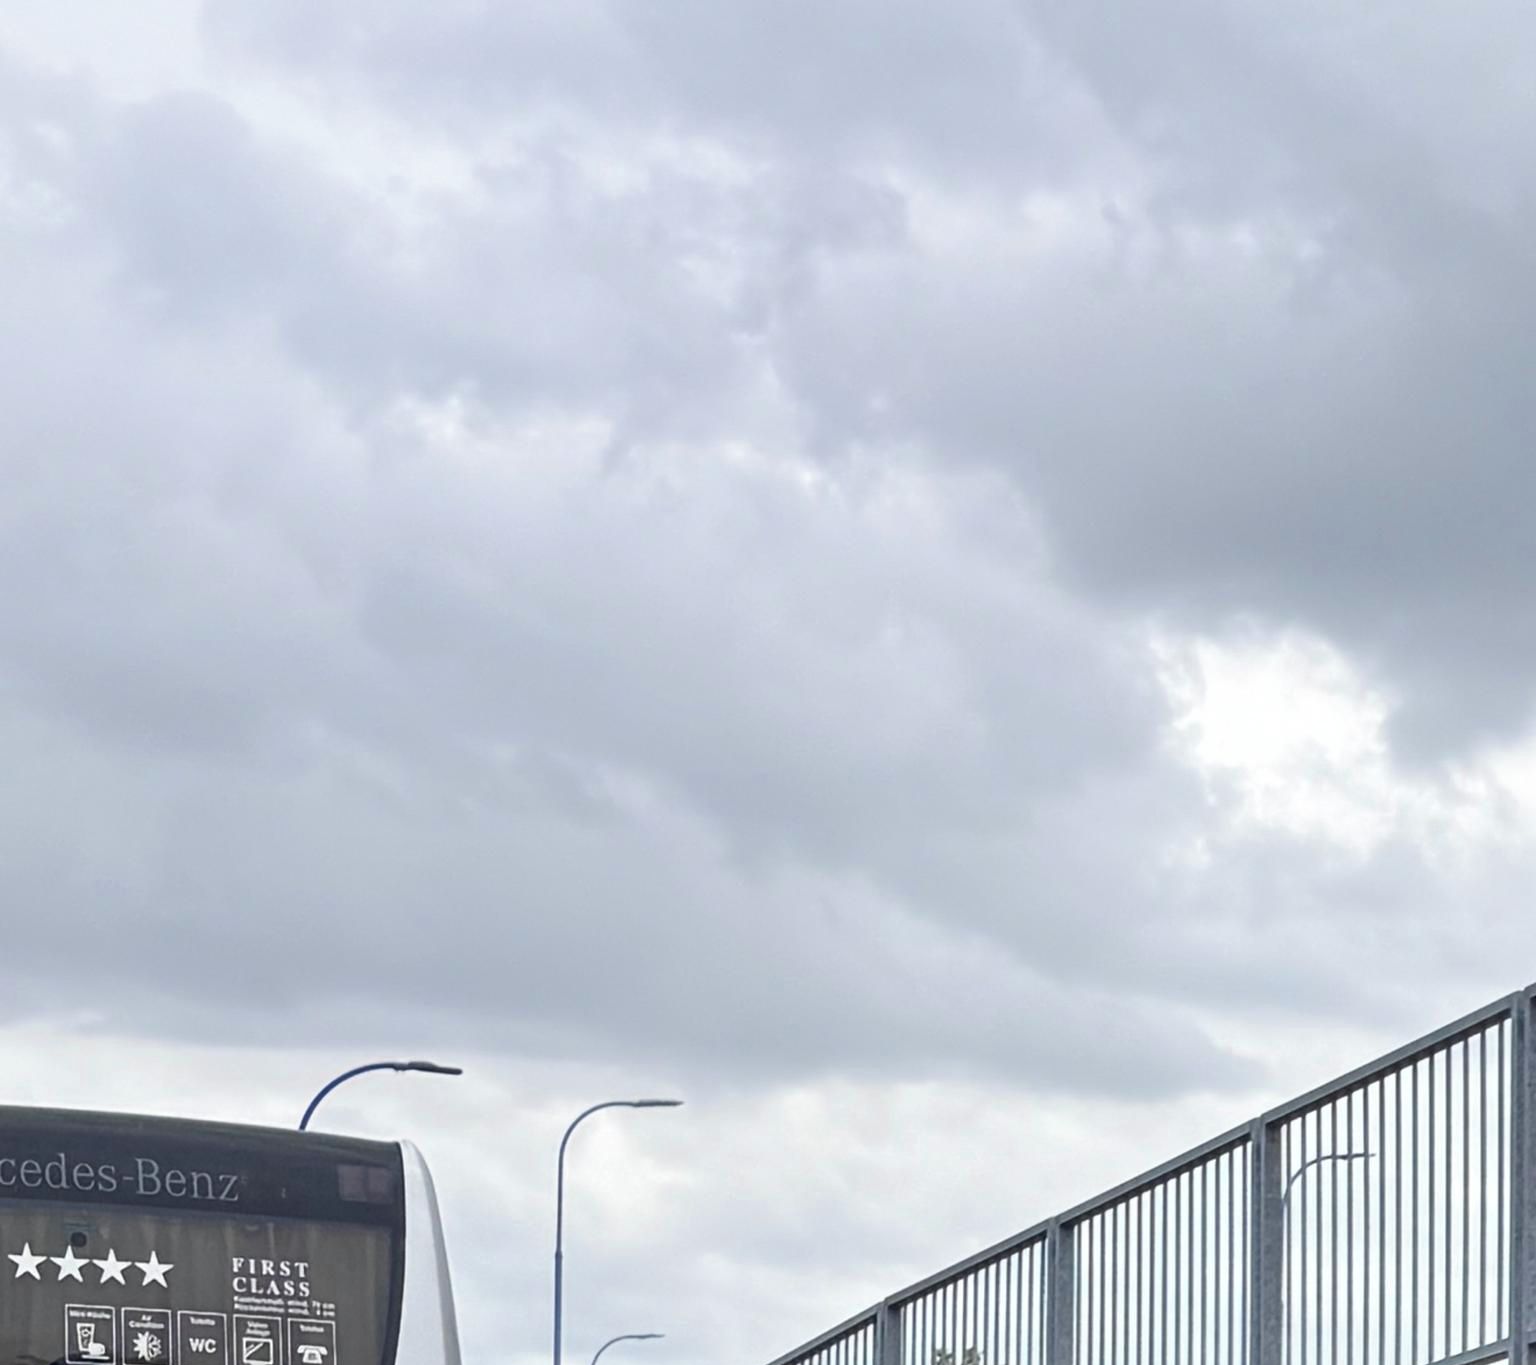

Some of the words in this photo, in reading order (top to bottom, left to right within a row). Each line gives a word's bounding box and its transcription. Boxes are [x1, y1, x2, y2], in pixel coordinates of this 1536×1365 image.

[0, 1153, 239, 1201] cedes-Benz
[232, 1257, 309, 1278] FIRST
[232, 1276, 310, 1297] CLASS
[189, 1338, 216, 1353] WC
